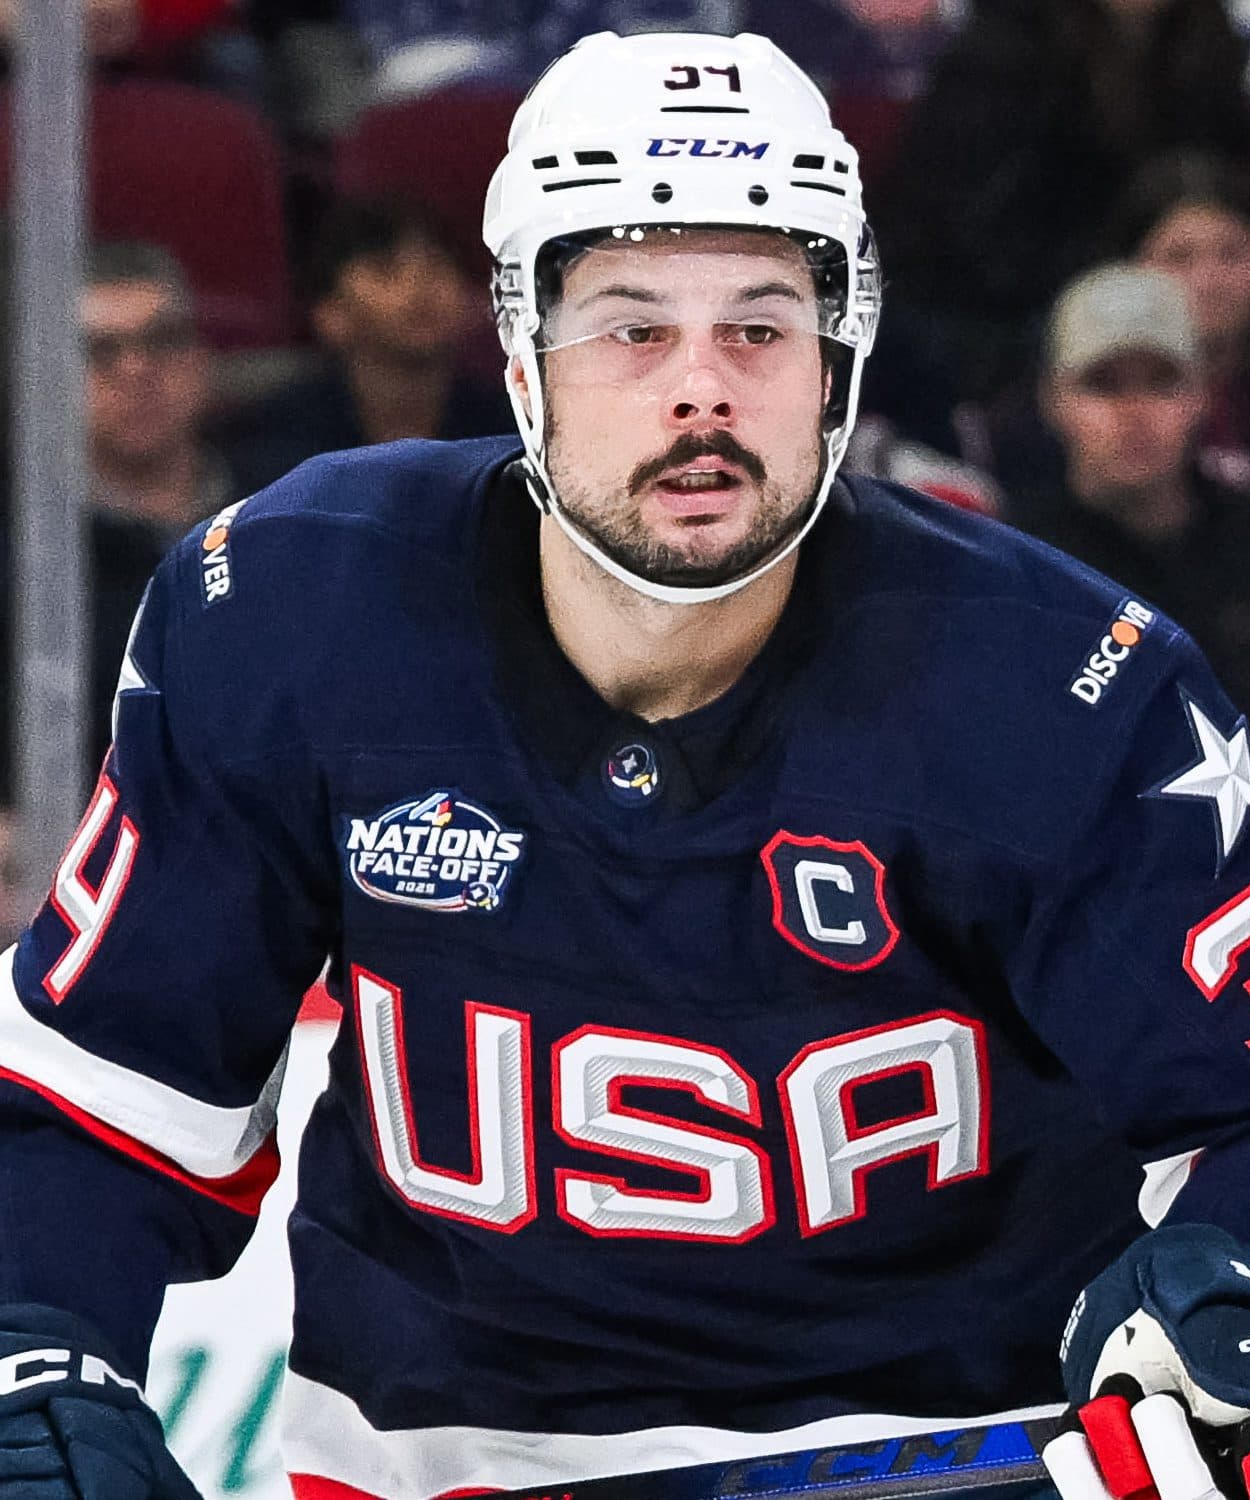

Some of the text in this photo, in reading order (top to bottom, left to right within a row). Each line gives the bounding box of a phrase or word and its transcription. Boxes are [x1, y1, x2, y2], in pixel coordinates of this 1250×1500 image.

[646, 138, 770, 160] CCM
[346, 819, 523, 861] NATIONS
[357, 851, 500, 884] FACE-OFF
[794, 860, 867, 944] C
[351, 962, 990, 1243] USA
